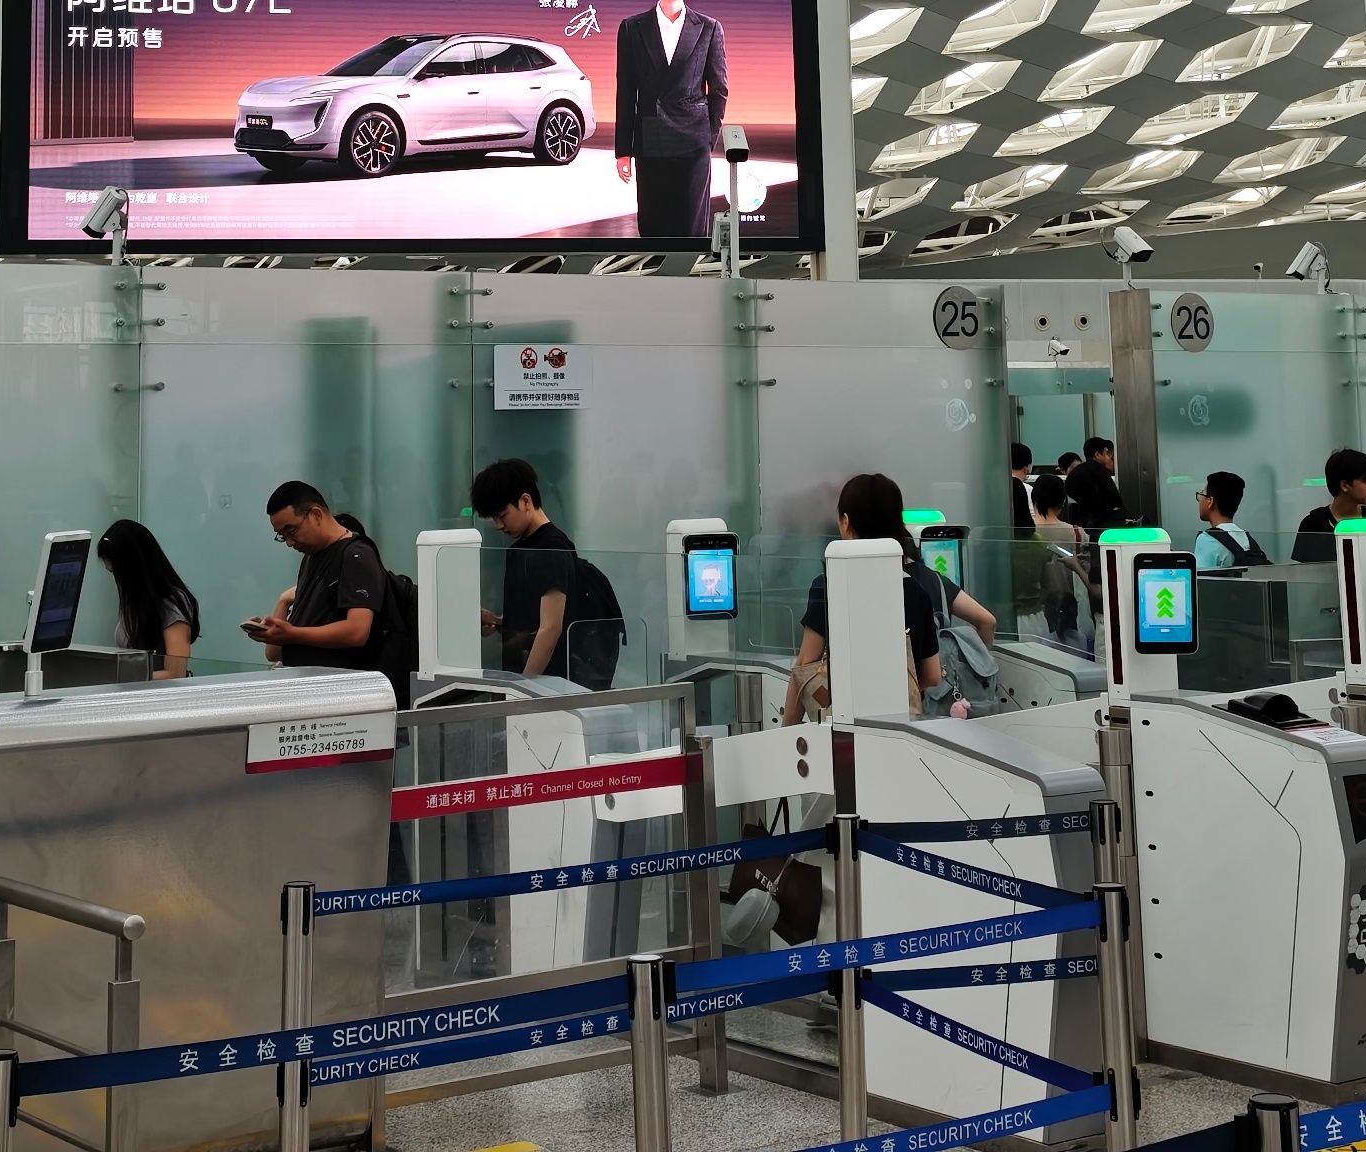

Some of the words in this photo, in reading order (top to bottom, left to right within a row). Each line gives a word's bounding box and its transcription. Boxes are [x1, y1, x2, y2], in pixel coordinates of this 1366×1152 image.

[67, 26, 163, 49] 开启预售
[165, 191, 211, 205] 联合设计
[941, 301, 979, 337] 25
[1176, 305, 1210, 340] 26
[279, 723, 317, 734] 服务热线
[279, 738, 365, 757] 0755-23456789
[426, 789, 476, 810] 通道关闭
[485, 782, 534, 801] 禁止通行
[540, 781, 574, 795] Channel
[577, 777, 604, 790] Closed
[608, 776, 620, 786] No
[621, 774, 642, 786] Entry
[966, 818, 1052, 839] 安全检查
[1062, 815, 1090, 829] SEC
[530, 862, 620, 890] 安全检查
[630, 856, 697, 878] SECURITY
[698, 846, 742, 869] CHECK
[897, 846, 946, 877] 安全检查
[951, 864, 993, 889] SECURITY
[992, 877, 1022, 898] CHECK
[370, 889, 422, 907] CHECK
[788, 941, 887, 973] 安全检查
[898, 928, 972, 955] SECURITY
[973, 920, 1024, 942] CHECK
[971, 963, 1056, 984] 安全检查
[699, 992, 744, 1012] CHECK
[179, 1034, 316, 1073] 安全检查
[332, 1014, 431, 1049] SECURITY
[434, 1004, 501, 1033] CHECK
[530, 1015, 620, 1046] 安全检查
[902, 1002, 951, 1039] 安全检查
[957, 1027, 1000, 1058] SECURITY
[998, 1045, 1029, 1069] CHECK
[368, 1052, 420, 1073] CHECK
[908, 1123, 981, 1150] SECURITY
[983, 1109, 1034, 1135] CHECK
